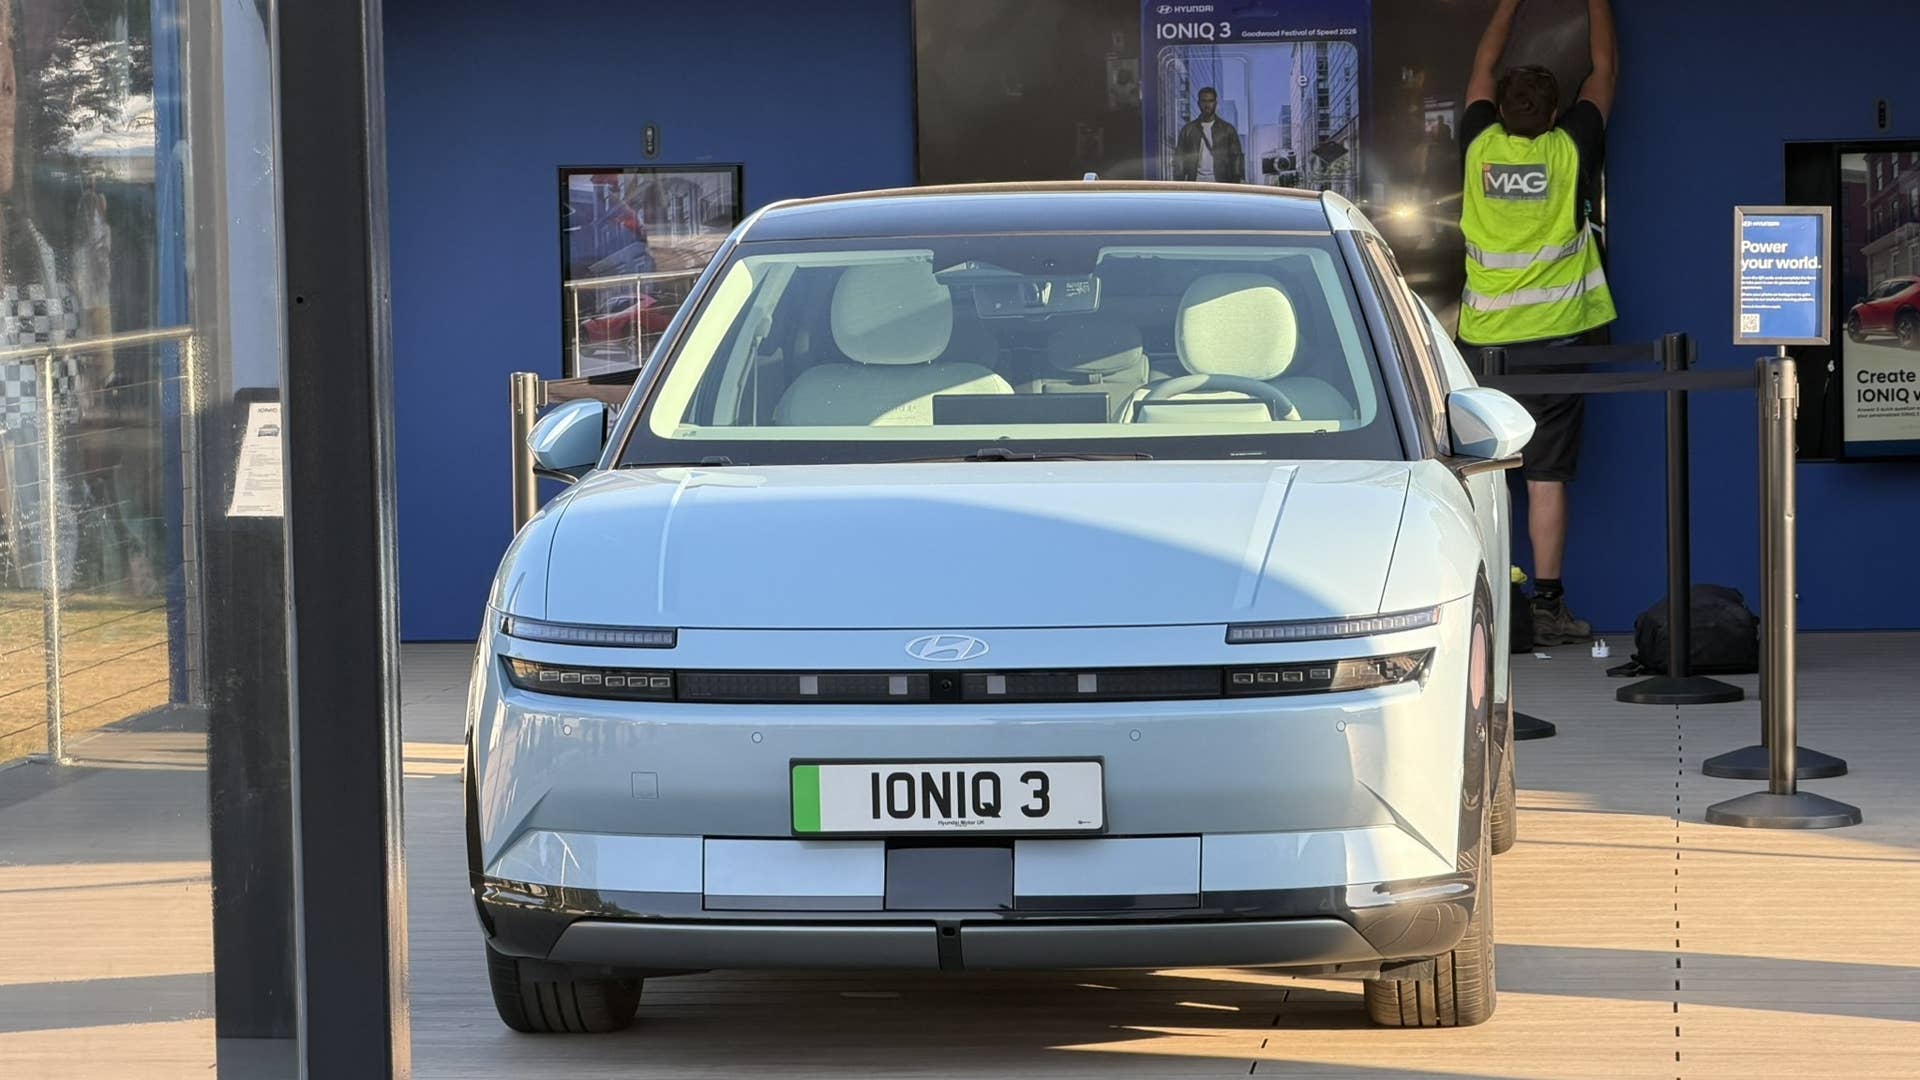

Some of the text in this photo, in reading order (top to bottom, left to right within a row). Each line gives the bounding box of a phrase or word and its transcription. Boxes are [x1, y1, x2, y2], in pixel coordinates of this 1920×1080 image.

[1174, 5, 1214, 13] HYUNDAI
[1157, 22, 1232, 40] IONIQ 3
[1241, 30, 1280, 38] Goodwood
[1316, 28, 1339, 36] Speed
[1742, 240, 1788, 253] Power
[1741, 256, 1822, 271] your world.
[1857, 369, 1916, 384] Create
[1857, 388, 1910, 404] IONIQ
[871, 770, 1050, 819] IONIQ 3
